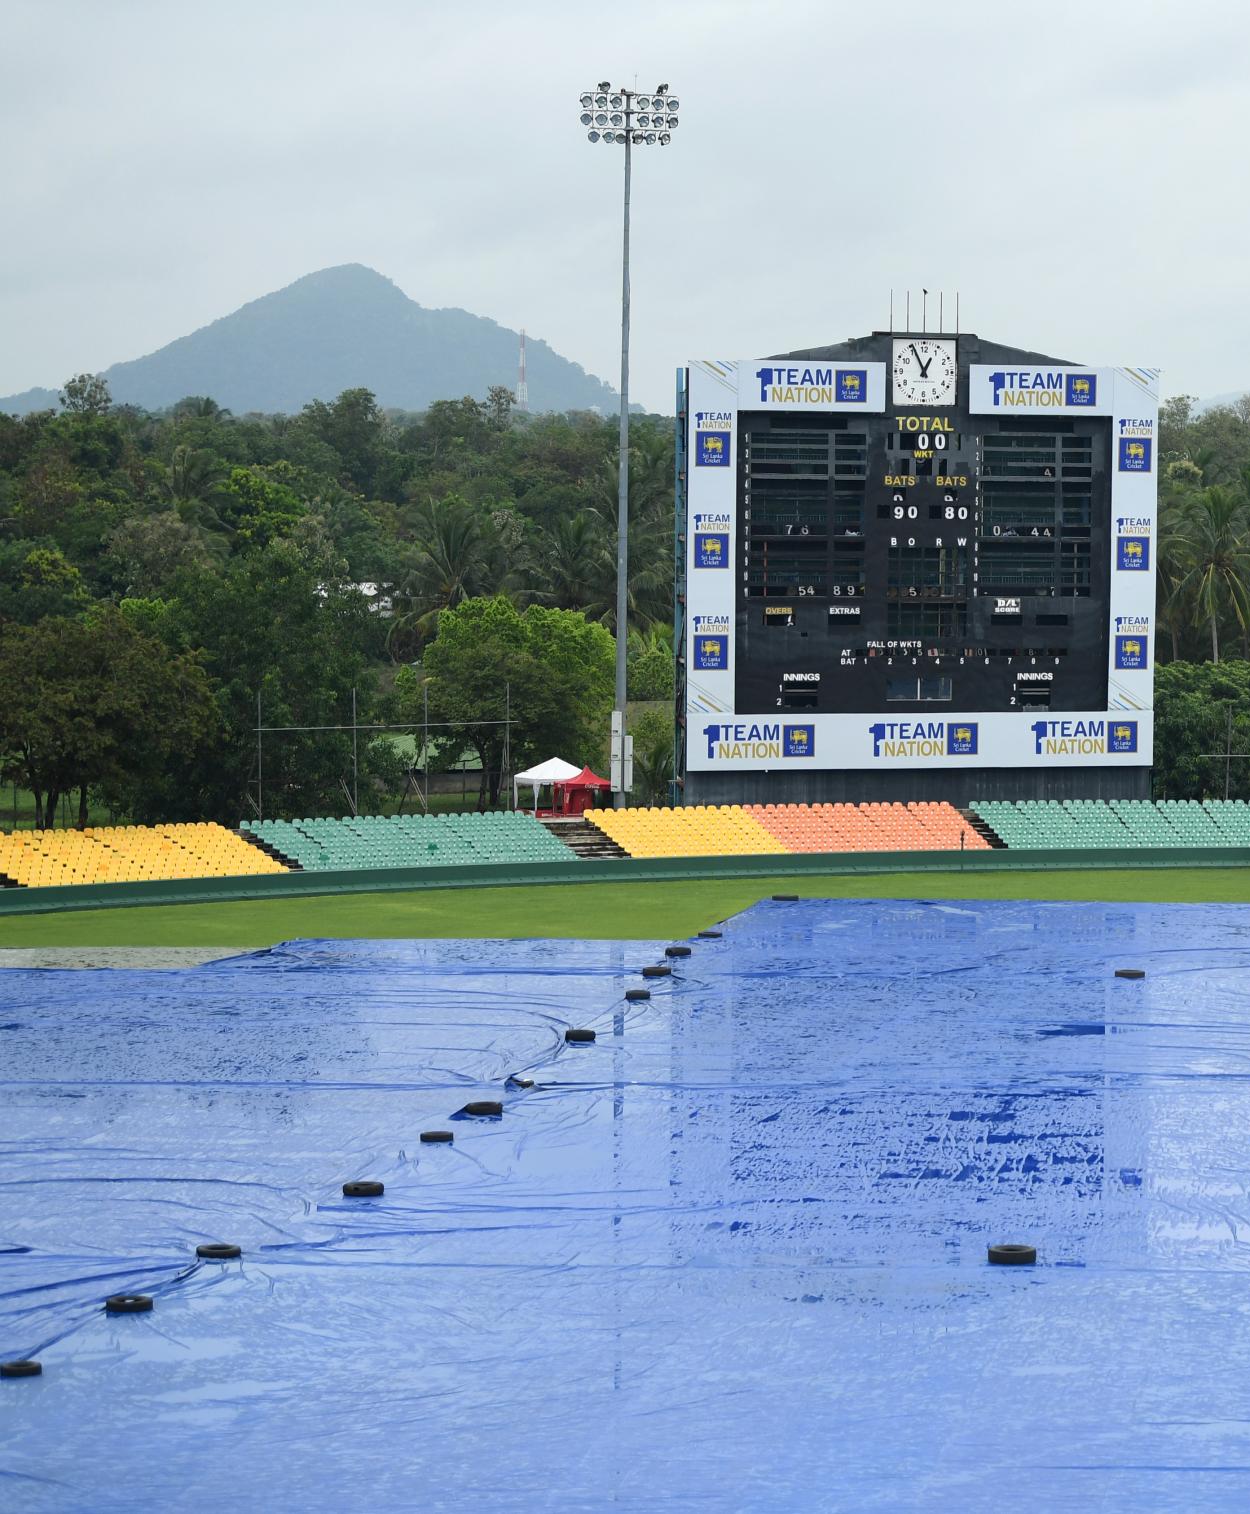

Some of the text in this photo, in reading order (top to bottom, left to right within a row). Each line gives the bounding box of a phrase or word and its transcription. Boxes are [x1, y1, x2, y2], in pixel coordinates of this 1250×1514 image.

[773, 369, 832, 385] TEAM
[1005, 373, 1062, 389] TEAM
[772, 387, 832, 403] NATION
[1004, 391, 1062, 406] NATION
[896, 417, 954, 431] TOTAL
[885, 476, 966, 486] BATS BATS
[1124, 518, 1150, 526] TEAM
[908, 538, 915, 546] O
[936, 538, 942, 546] R
[958, 538, 966, 546] W
[701, 616, 729, 624] TEAM
[783, 673, 820, 681] INNINGS
[721, 725, 780, 741] TEAM
[886, 723, 944, 739] TEAM
[1048, 721, 1104, 737] TEAM
[719, 743, 780, 758] NATION
[884, 741, 944, 757] NATION
[1046, 739, 1104, 754] NATION
